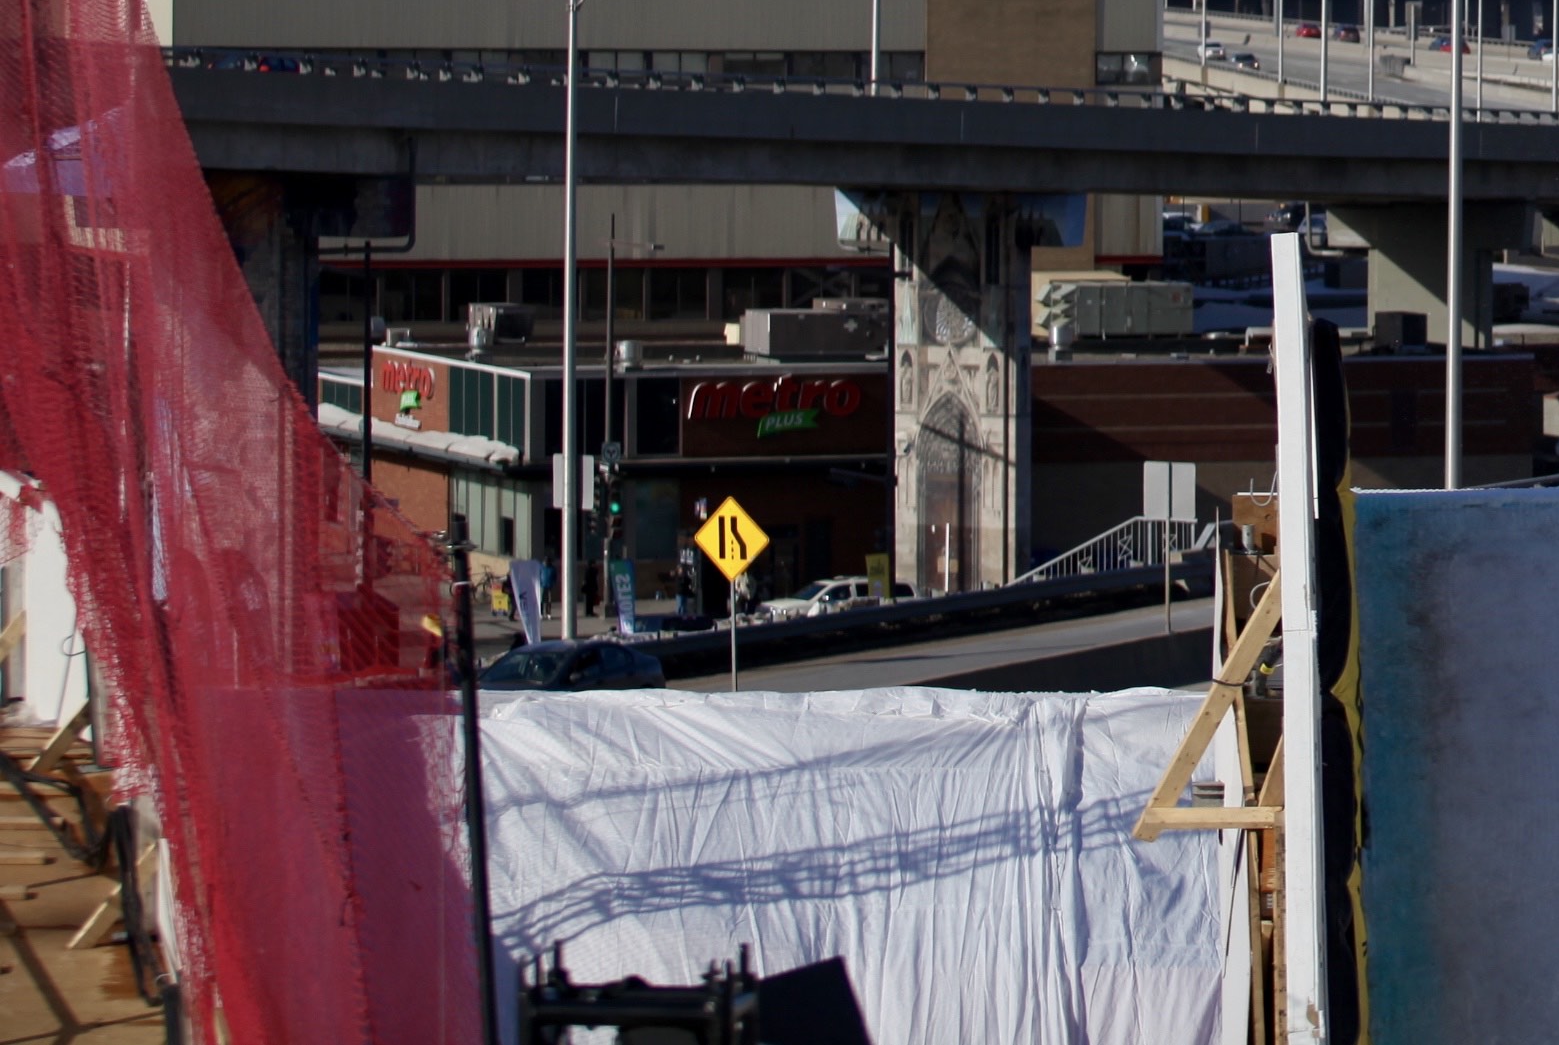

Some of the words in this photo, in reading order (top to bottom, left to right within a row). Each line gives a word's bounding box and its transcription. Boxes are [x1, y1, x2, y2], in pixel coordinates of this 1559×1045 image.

[381, 359, 434, 399] metro
[688, 373, 861, 419] metro
[765, 412, 803, 431] PLUS
